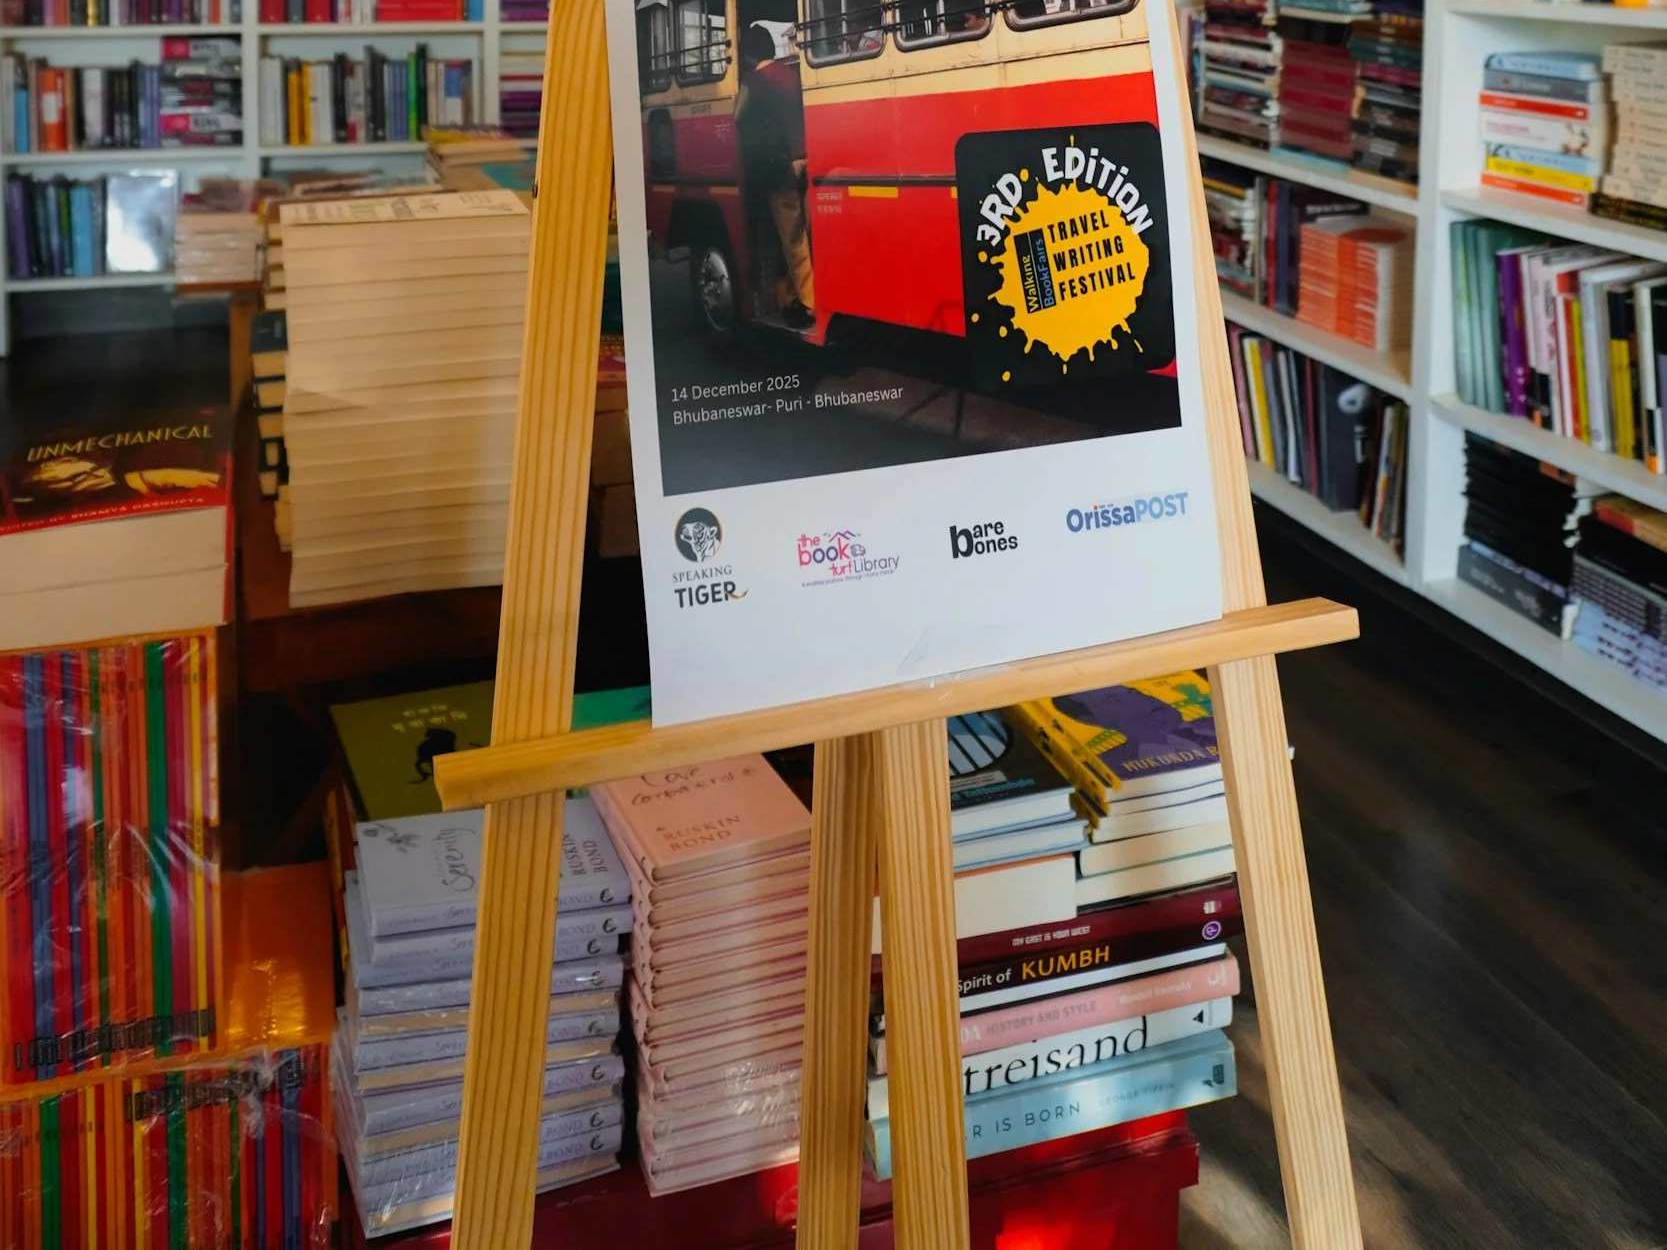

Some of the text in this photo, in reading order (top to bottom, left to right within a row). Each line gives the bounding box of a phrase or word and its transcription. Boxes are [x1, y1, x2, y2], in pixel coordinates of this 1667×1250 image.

[976, 173, 1023, 247] 3RD
[1048, 210, 1109, 243] TRAVEL
[1053, 235, 1124, 272] WRITING
[1021, 254, 1038, 312] Walking
[1035, 238, 1055, 307] BookFairs
[1059, 262, 1136, 302] FESTIVAL
[671, 374, 801, 402] 14 December 2025
[776, 396, 803, 413] Puri
[815, 386, 904, 409] Bhubaneswar
[27, 424, 213, 462] UNMECHANICAL
[132, 498, 204, 510] DASGUPTA
[797, 534, 821, 547] the
[798, 538, 850, 566] book
[672, 566, 733, 583] SPEAKING
[829, 555, 900, 576] turf Library
[674, 581, 738, 608] TIGER
[1122, 749, 1206, 772] MUKUNDA
[663, 814, 742, 842] RUSKIN
[670, 830, 731, 851] BOND
[432, 827, 476, 892] Serenity
[562, 834, 587, 876] RUSKIN
[582, 840, 608, 873] BOND
[1012, 926, 1091, 947] MY EAST IS YOUR WEST
[958, 945, 1110, 994] Spirit of KUMBH
[986, 1015, 1034, 1035] HISTORY
[1038, 1009, 1060, 1023] AND
[1063, 1001, 1097, 1019] STYLE
[963, 1015, 1149, 1095] treisand
[1099, 1090, 1139, 1106] GEORGE
[995, 1117, 1012, 1132] IS
[1025, 1101, 1081, 1127] BORN
